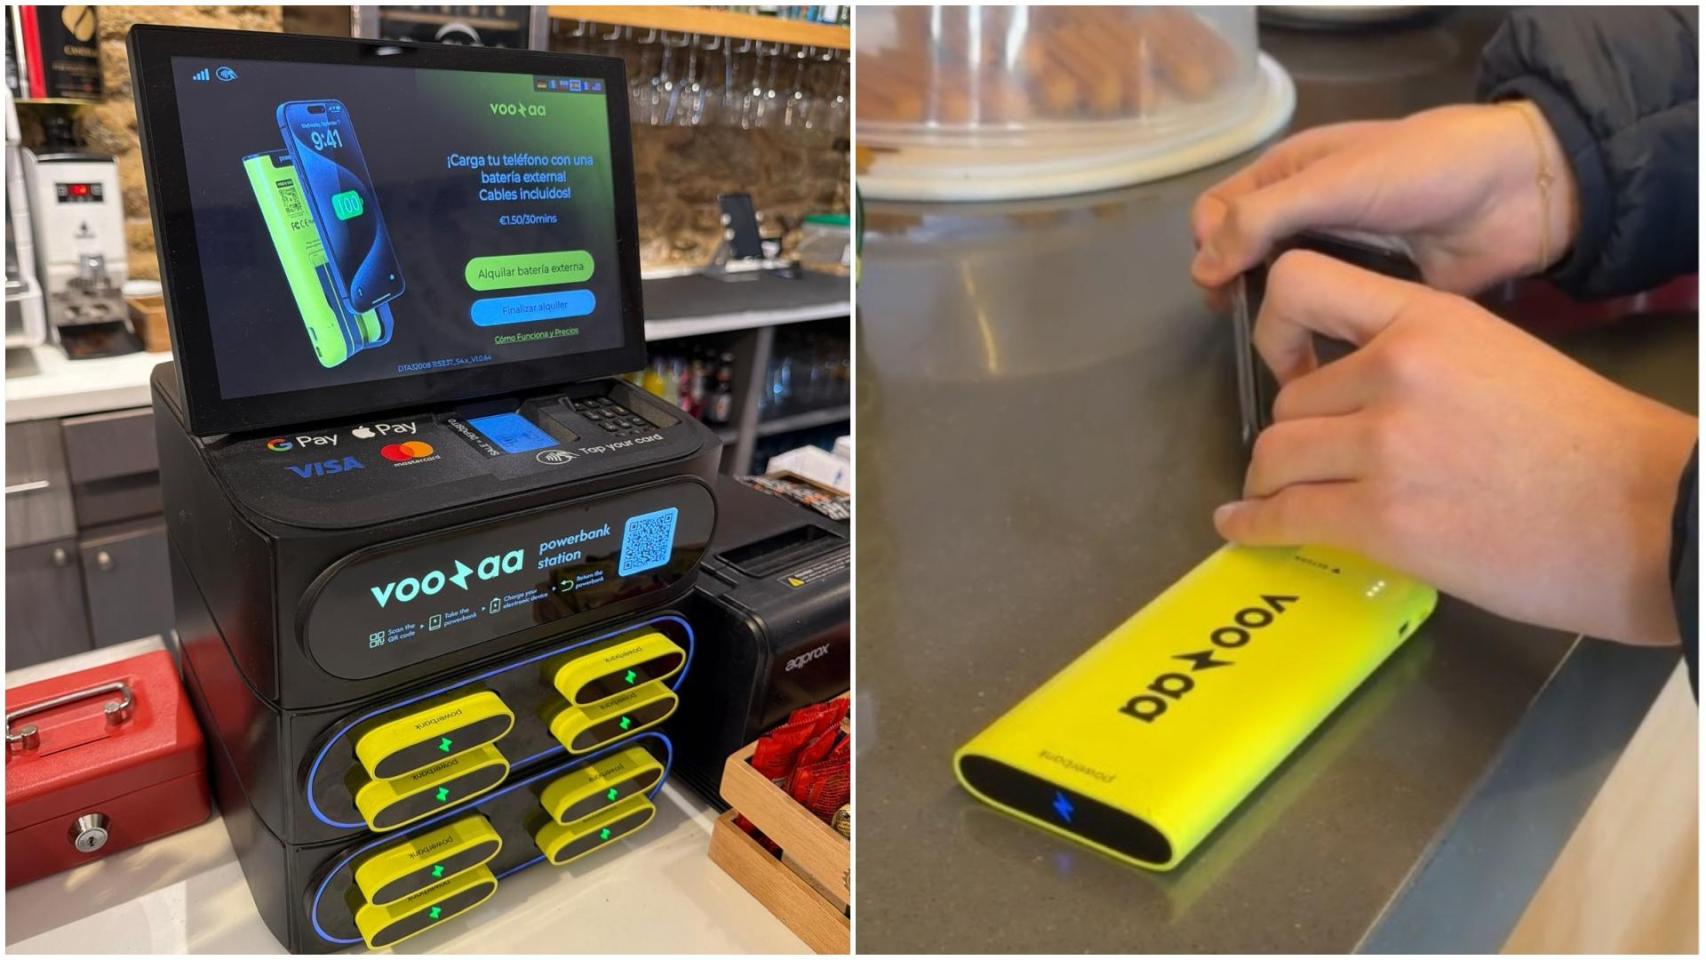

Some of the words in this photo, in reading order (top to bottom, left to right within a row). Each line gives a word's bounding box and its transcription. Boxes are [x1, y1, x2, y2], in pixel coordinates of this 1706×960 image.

[311, 129, 343, 151] 9:41
[488, 154, 500, 166] tu
[503, 153, 549, 166] teléfono
[551, 156, 571, 167] con
[573, 155, 593, 166] una
[481, 171, 521, 184] batería
[479, 188, 518, 201] Cables
[478, 266, 515, 281] Alquilar
[517, 264, 550, 276] batería
[551, 262, 584, 273] externa
[502, 305, 536, 316] Finalizar
[538, 301, 568, 312] alquiler
[517, 331, 549, 342] Funciona
[555, 327, 580, 337] Precios
[375, 422, 417, 435] Pay
[296, 434, 338, 448] Pay
[578, 445, 606, 455] Tap
[606, 439, 633, 452] your
[634, 433, 664, 444] card
[284, 456, 366, 479] VISA
[394, 454, 441, 468] mastercard
[539, 522, 611, 556] powerbank
[537, 550, 581, 569] station
[460, 607, 470, 615] the
[405, 623, 416, 631] the
[415, 708, 462, 731] powerbank
